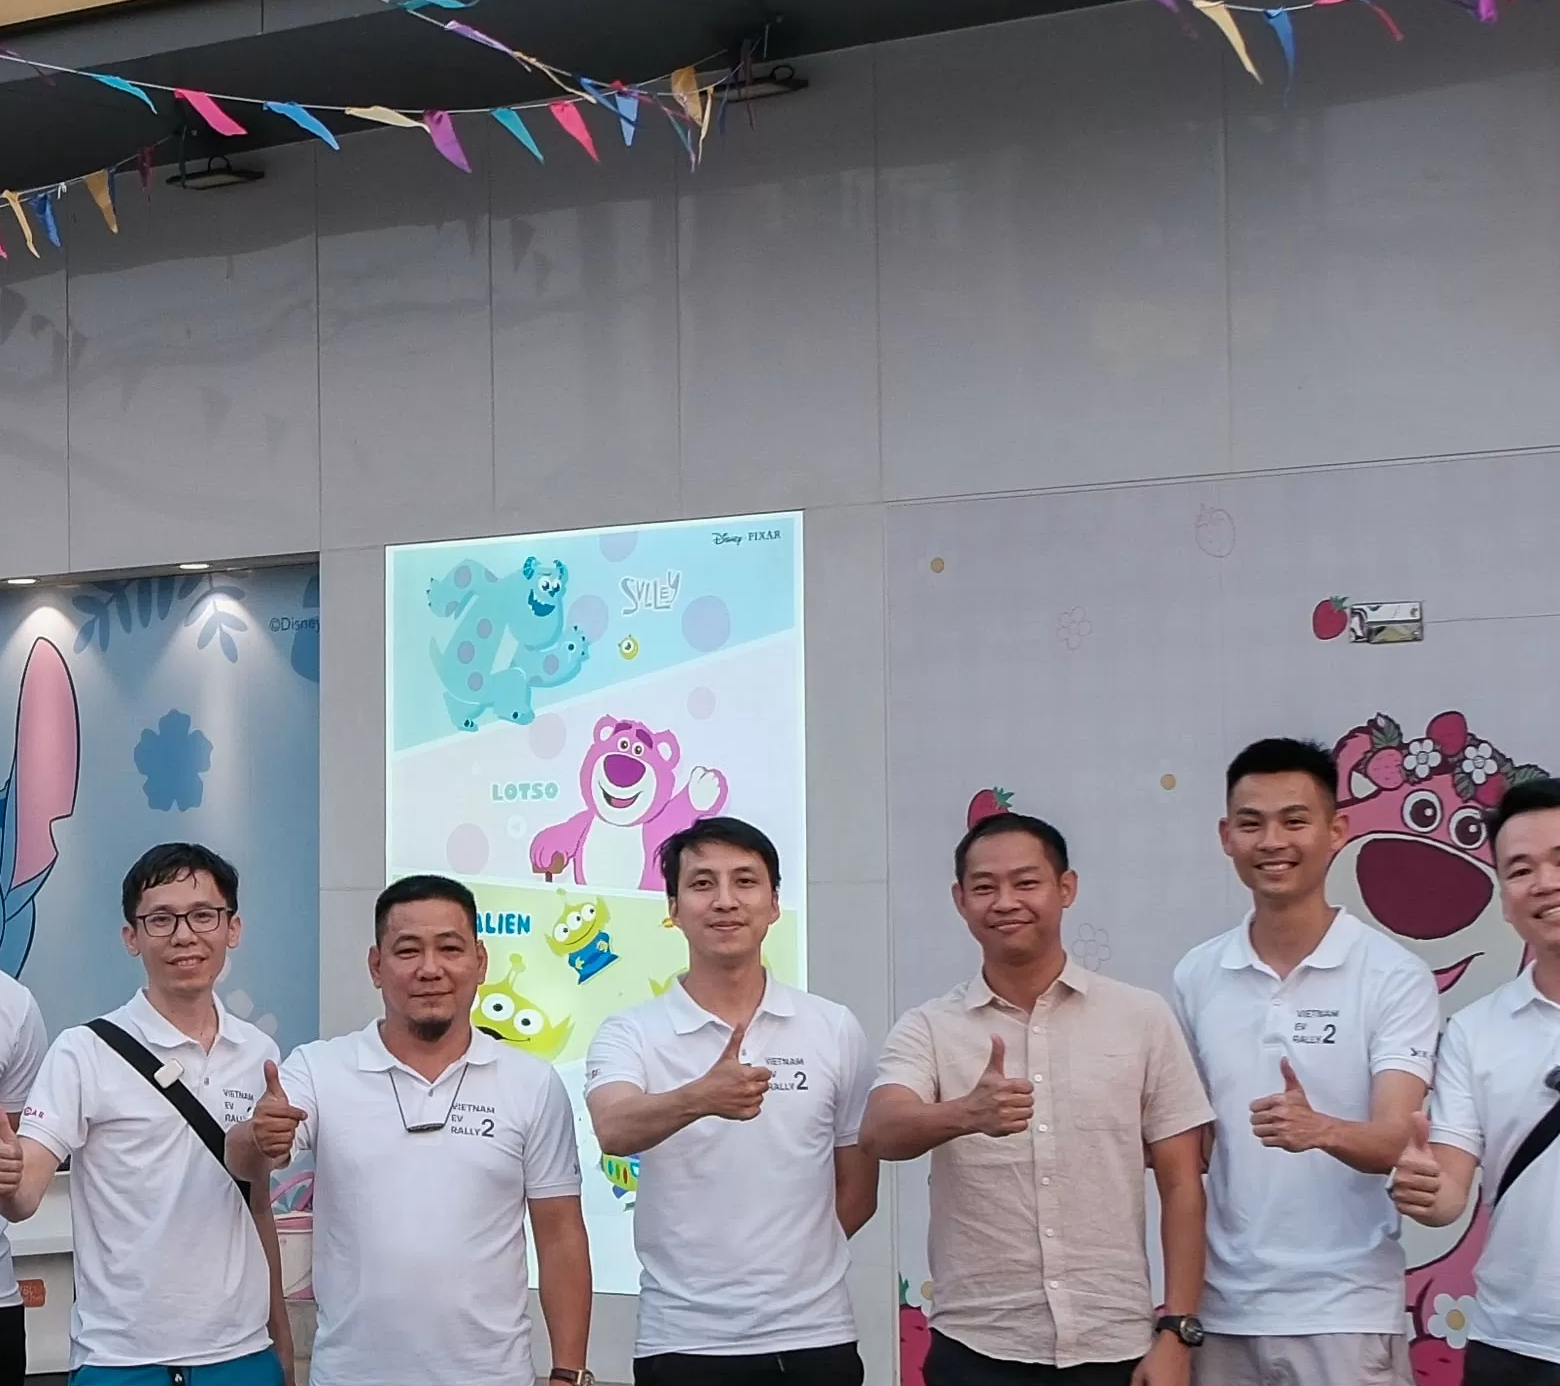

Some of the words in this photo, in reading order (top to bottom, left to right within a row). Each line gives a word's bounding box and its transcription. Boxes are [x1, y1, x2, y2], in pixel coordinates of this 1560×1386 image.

[747, 530, 782, 542] PIXAR
[491, 781, 560, 802] LOTSO
[1322, 1023, 1337, 1045] 2
[794, 1070, 809, 1091] 2
[450, 1126, 482, 1136] RALLY
[481, 1118, 495, 1138] 2
[451, 1114, 464, 1123] EV
